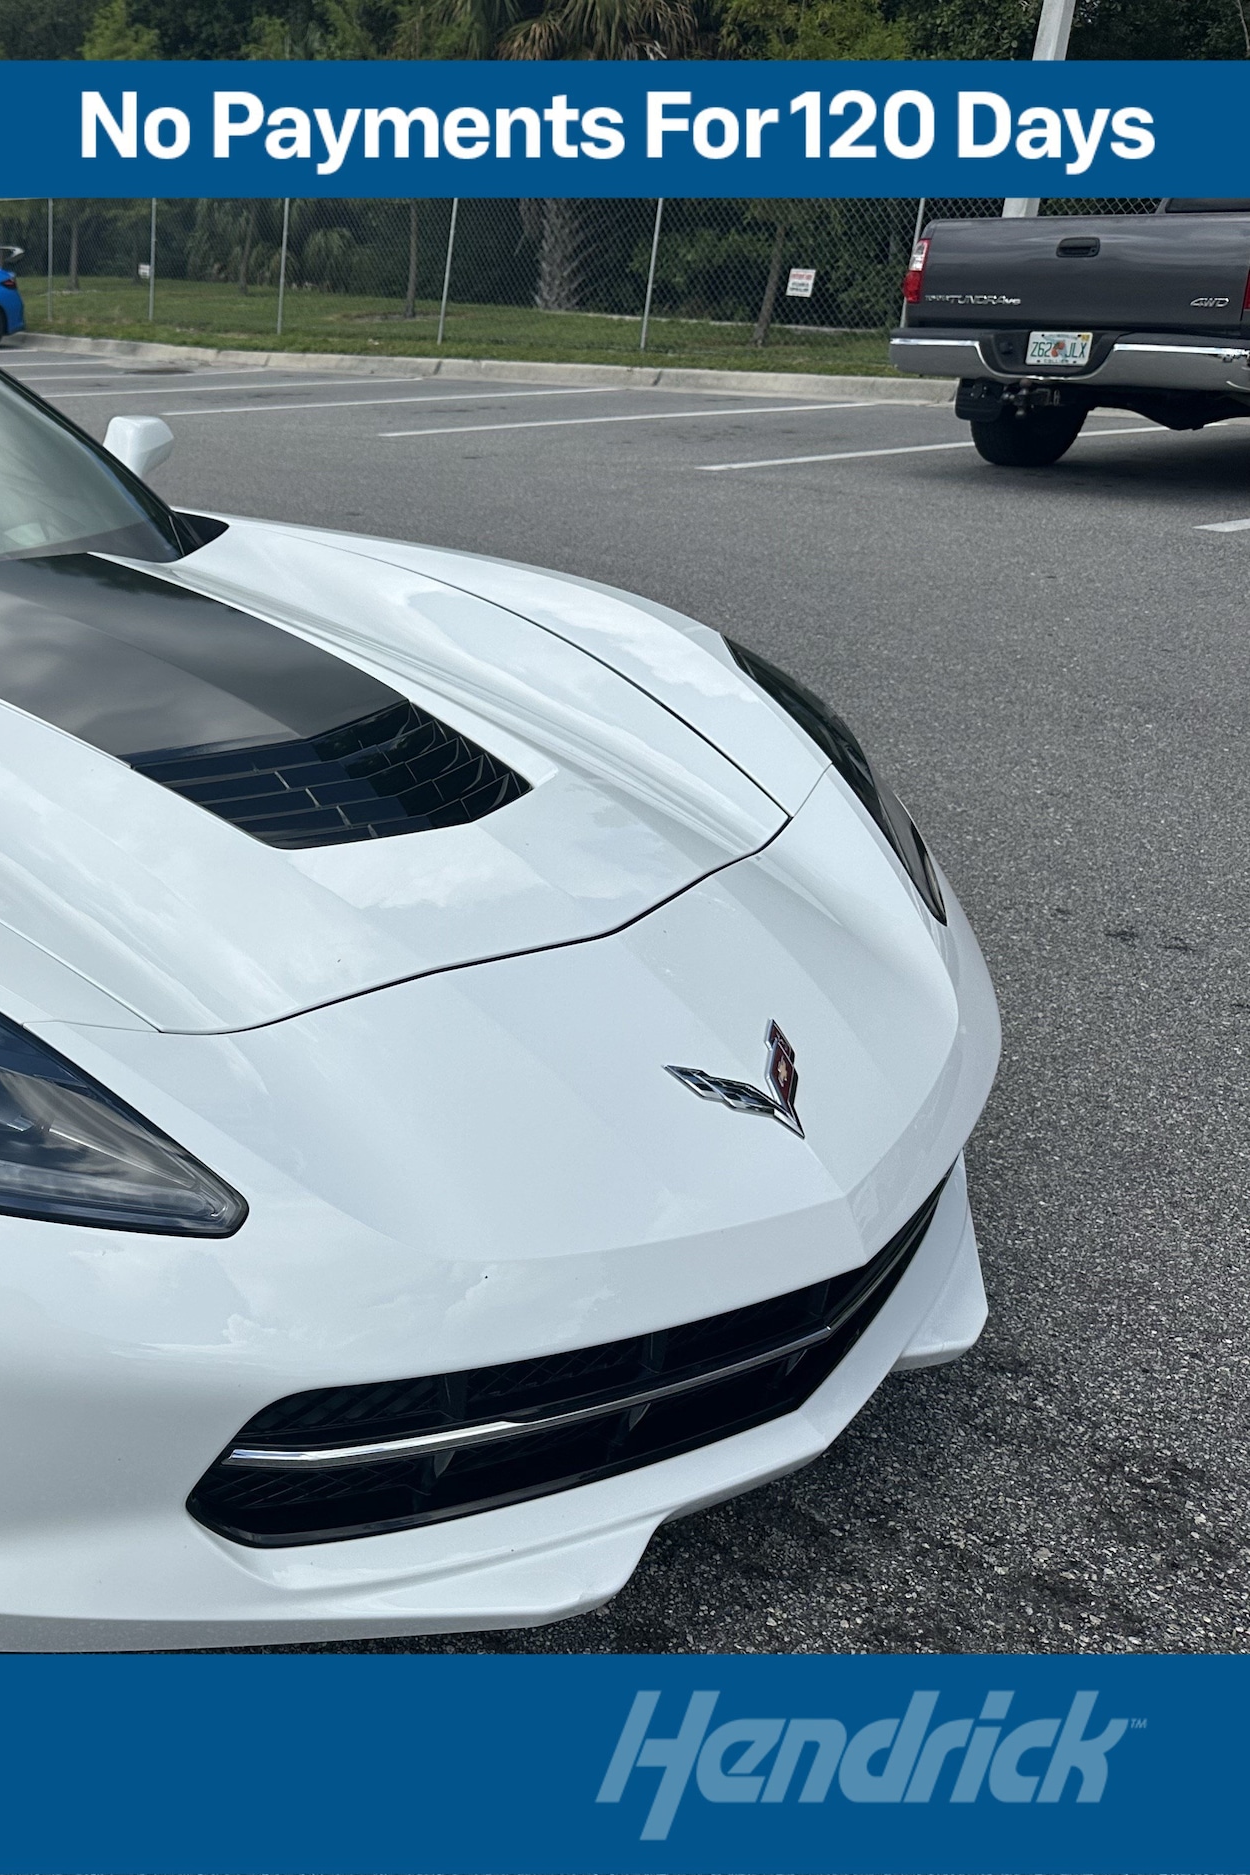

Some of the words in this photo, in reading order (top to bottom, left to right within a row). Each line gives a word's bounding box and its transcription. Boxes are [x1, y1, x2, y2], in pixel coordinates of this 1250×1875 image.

[1190, 297, 1230, 307] 4WD
[1030, 341, 1053, 358] Z62
[1064, 342, 1087, 358] JLX
